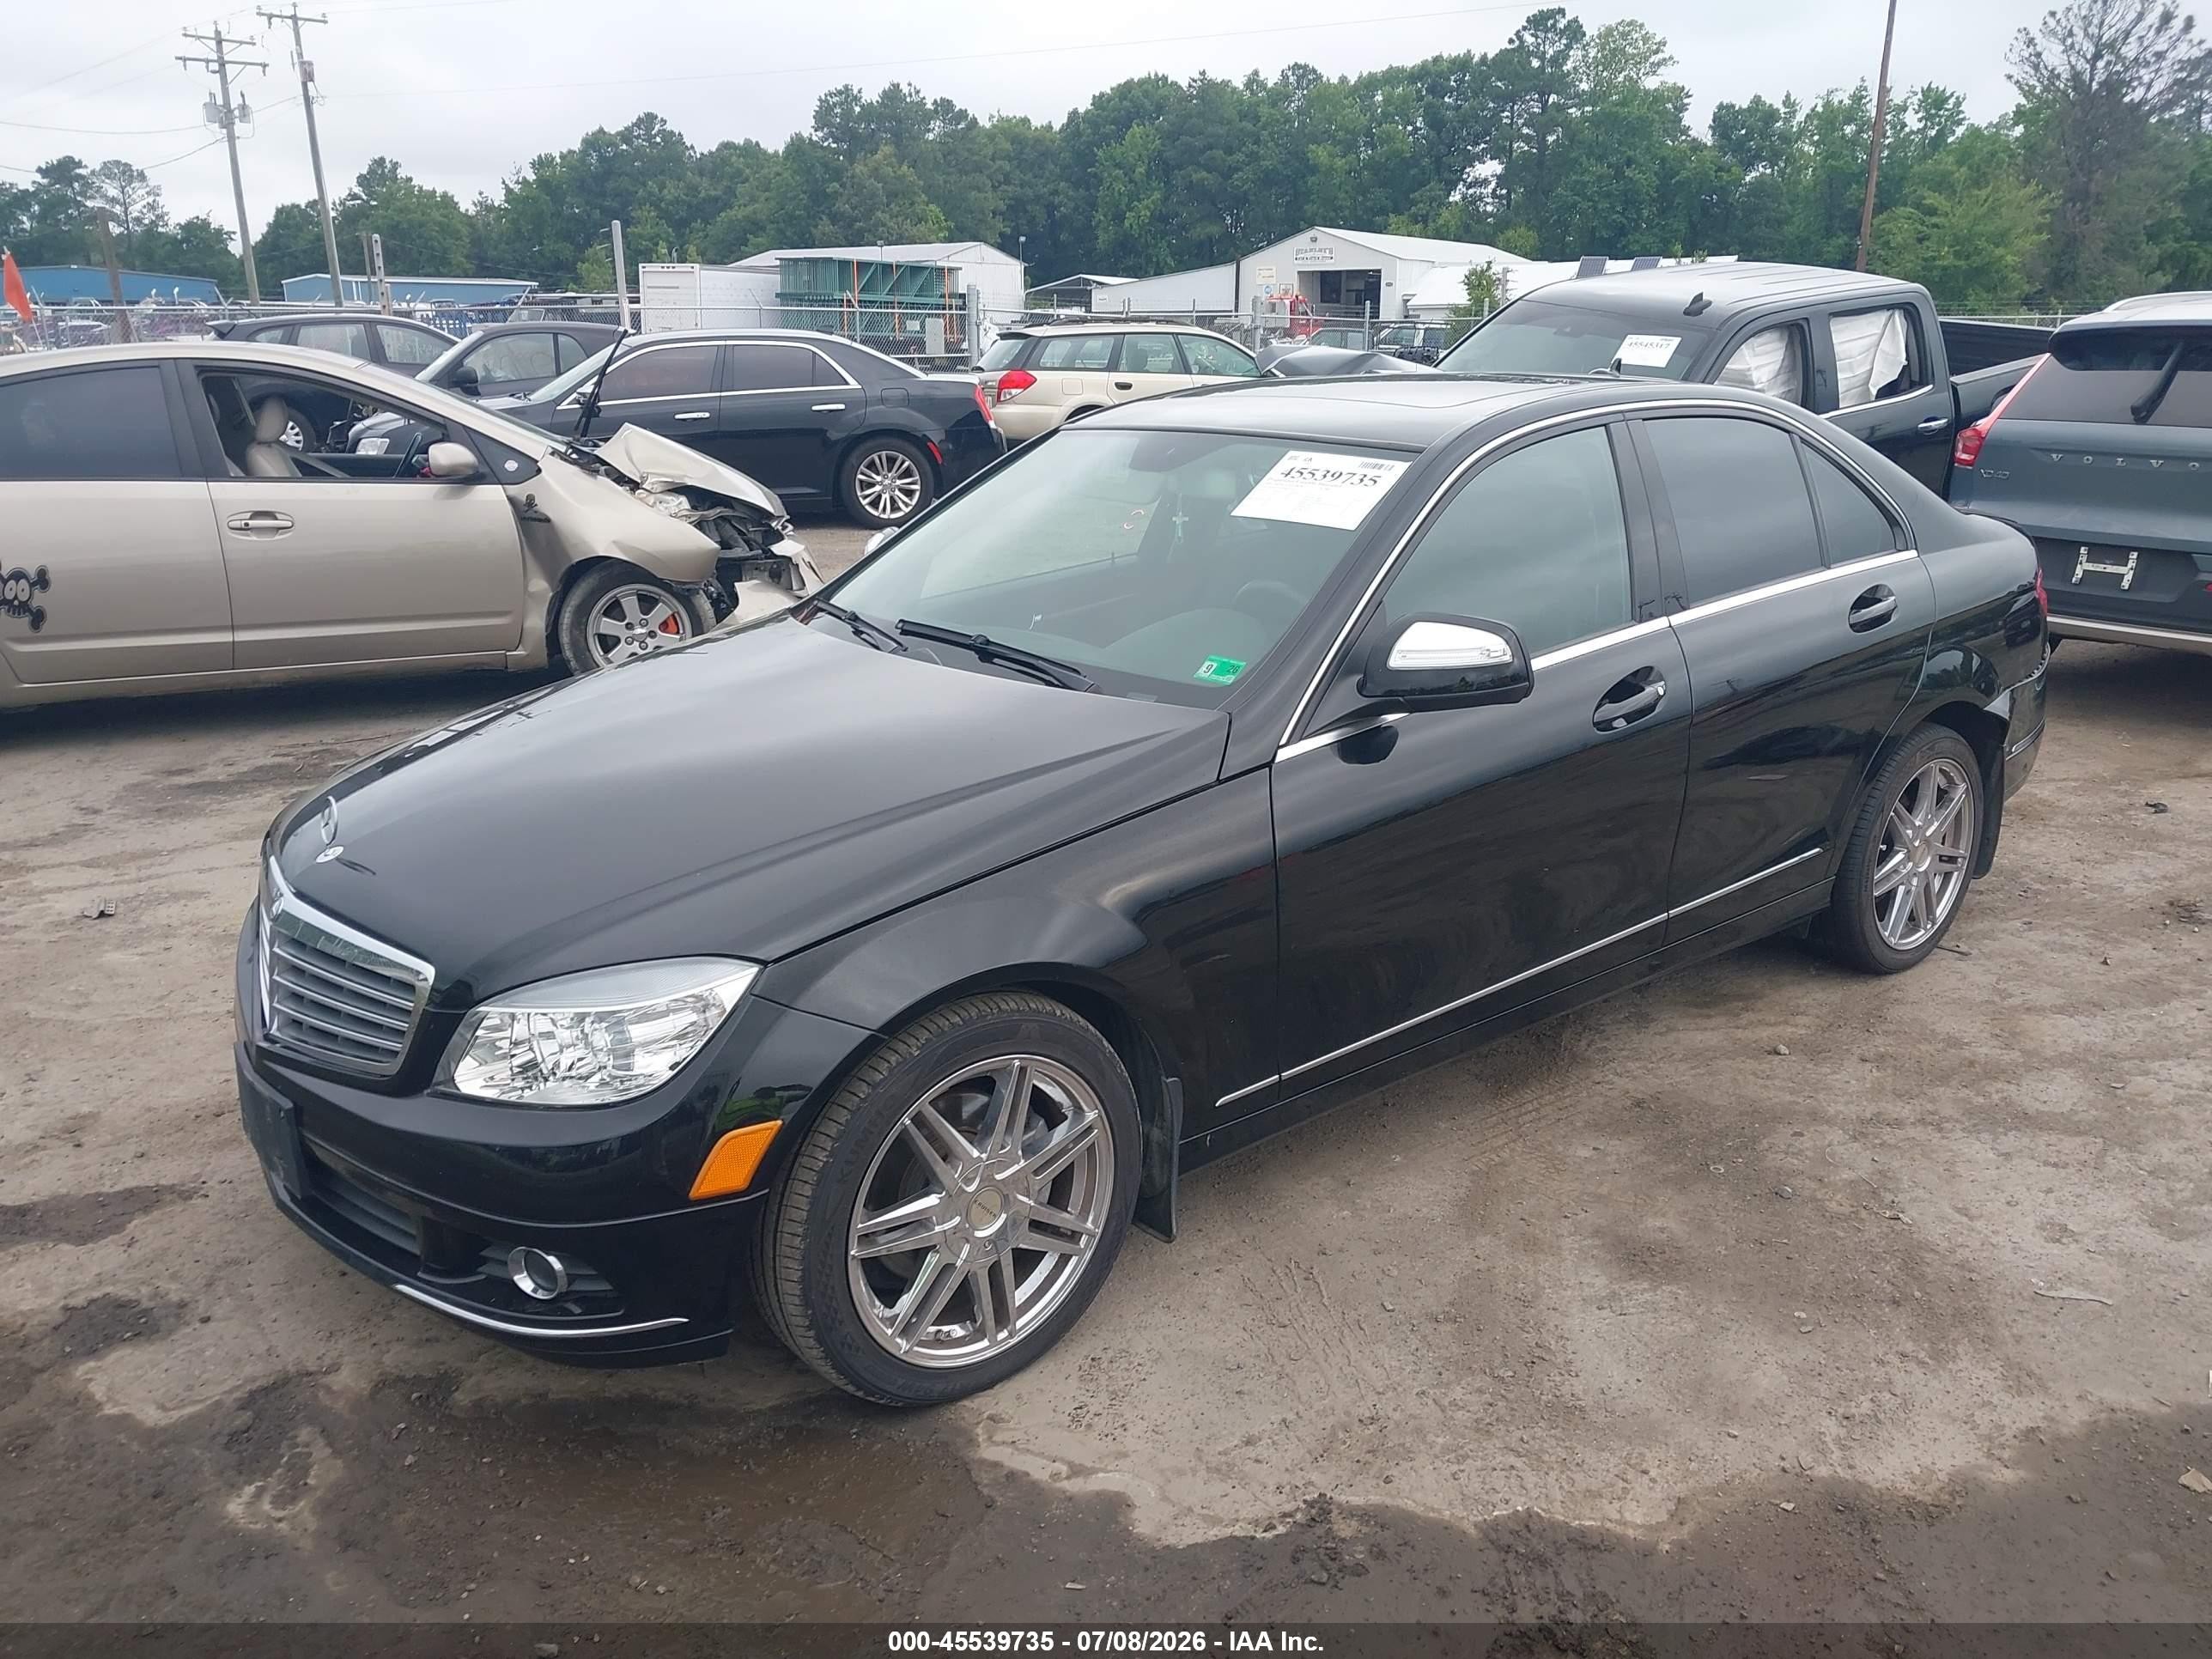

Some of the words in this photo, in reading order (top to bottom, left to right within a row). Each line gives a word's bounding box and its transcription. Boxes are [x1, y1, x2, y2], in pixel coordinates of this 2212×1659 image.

[2051, 453, 2200, 471] VOLVO
[1280, 467, 1381, 487] 45539735
[1204, 664, 1213, 674] 9
